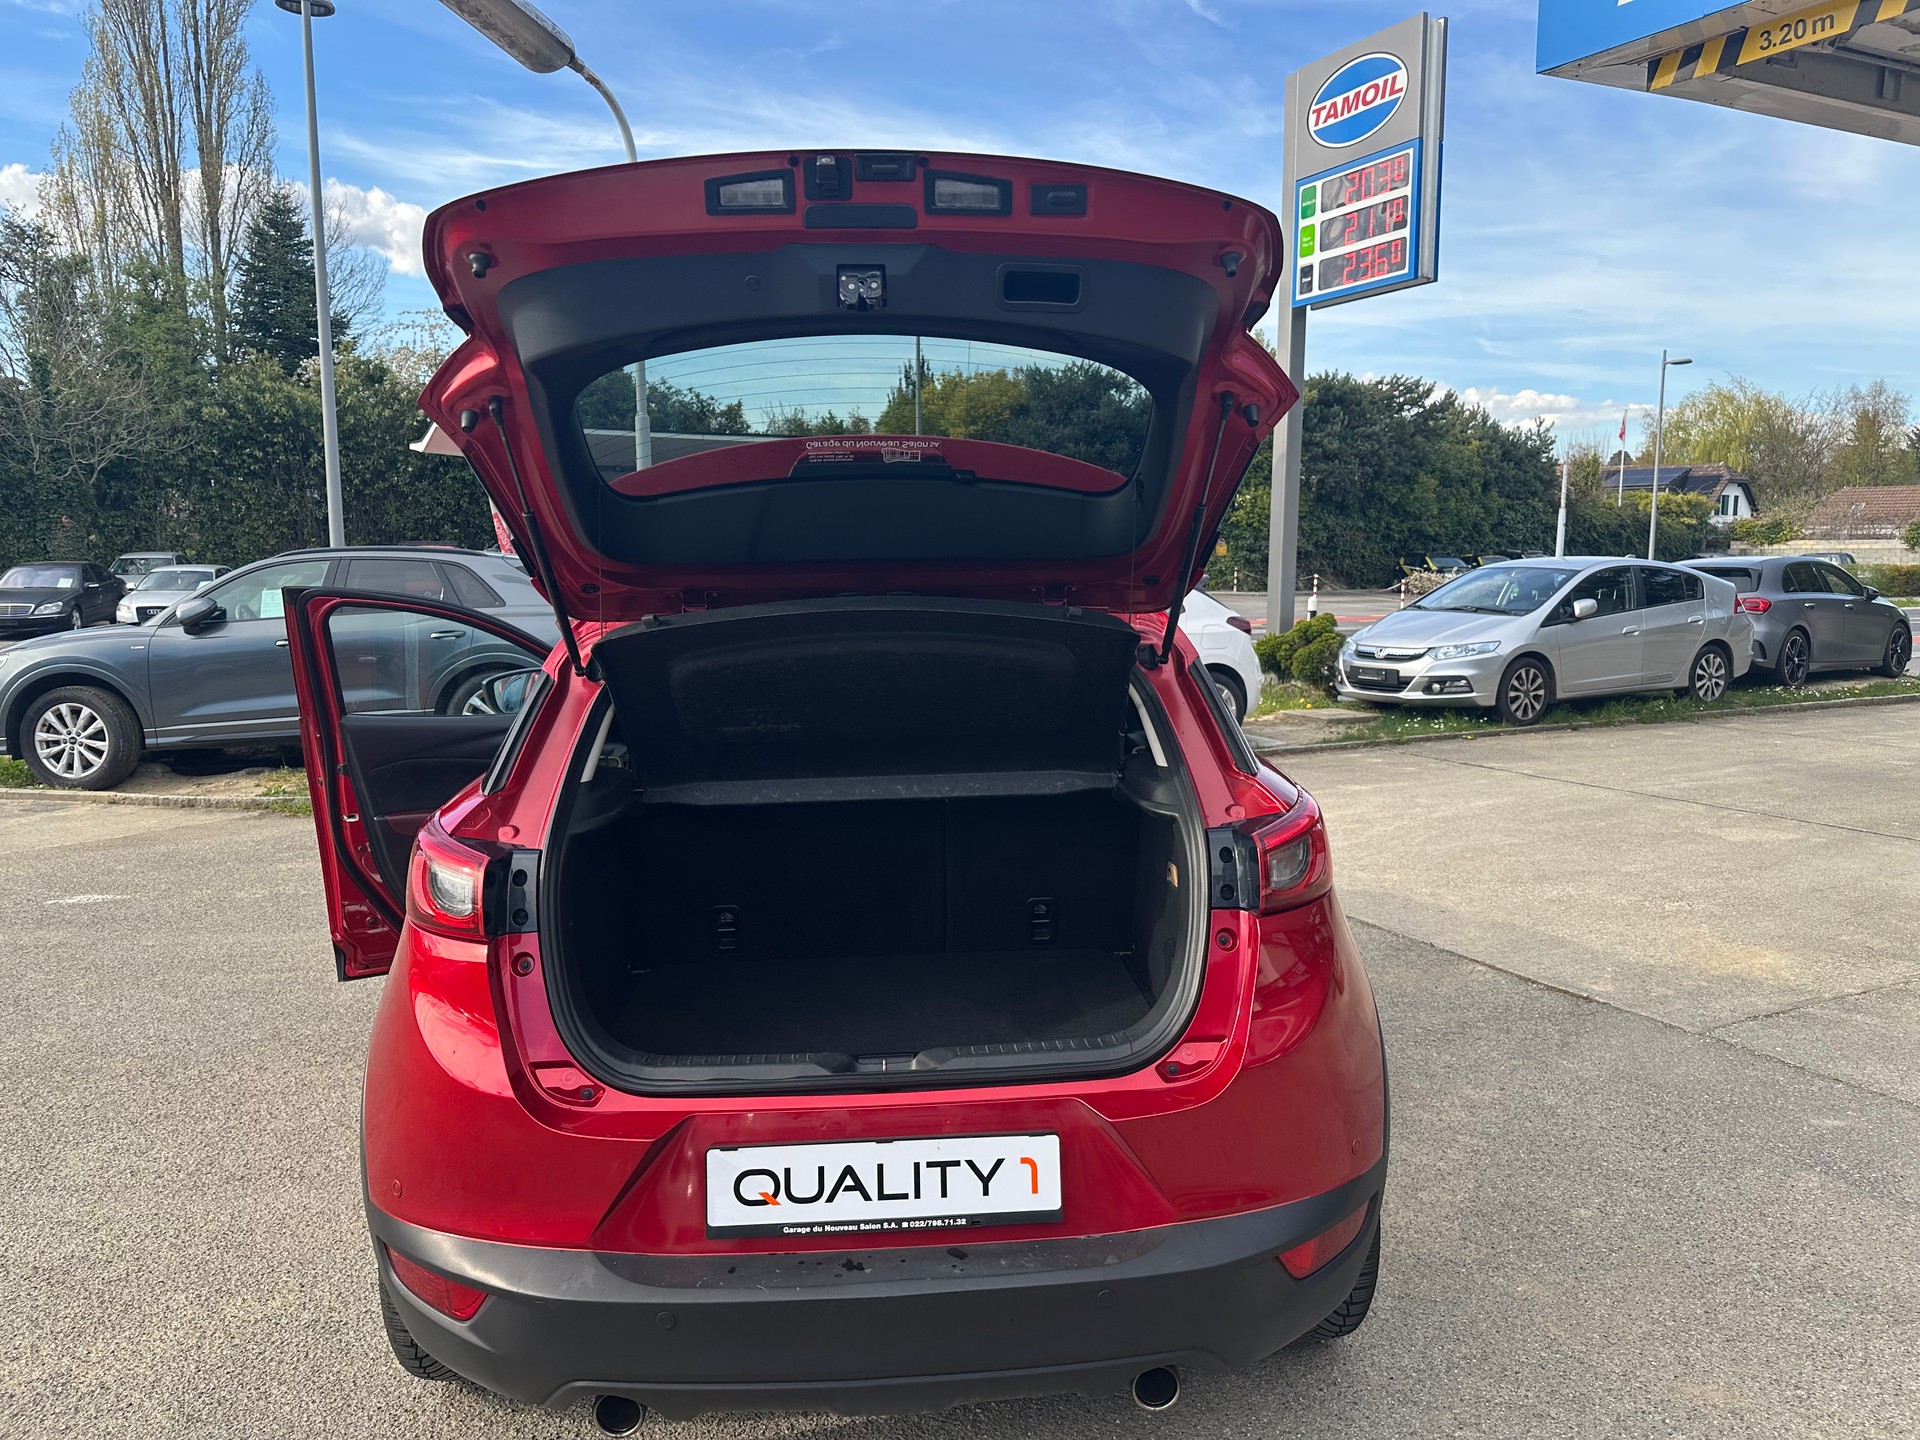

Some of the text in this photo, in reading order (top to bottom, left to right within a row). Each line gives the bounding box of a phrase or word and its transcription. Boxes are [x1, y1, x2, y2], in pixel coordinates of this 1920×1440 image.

[1759, 14, 1835, 51] 3.20 m
[1312, 75, 1404, 127] TAMOIL
[733, 1157, 1039, 1207] QUALITY 1
[783, 1218, 967, 1236] Garage du Nouveau Salon S.A. 022/798.71.32
